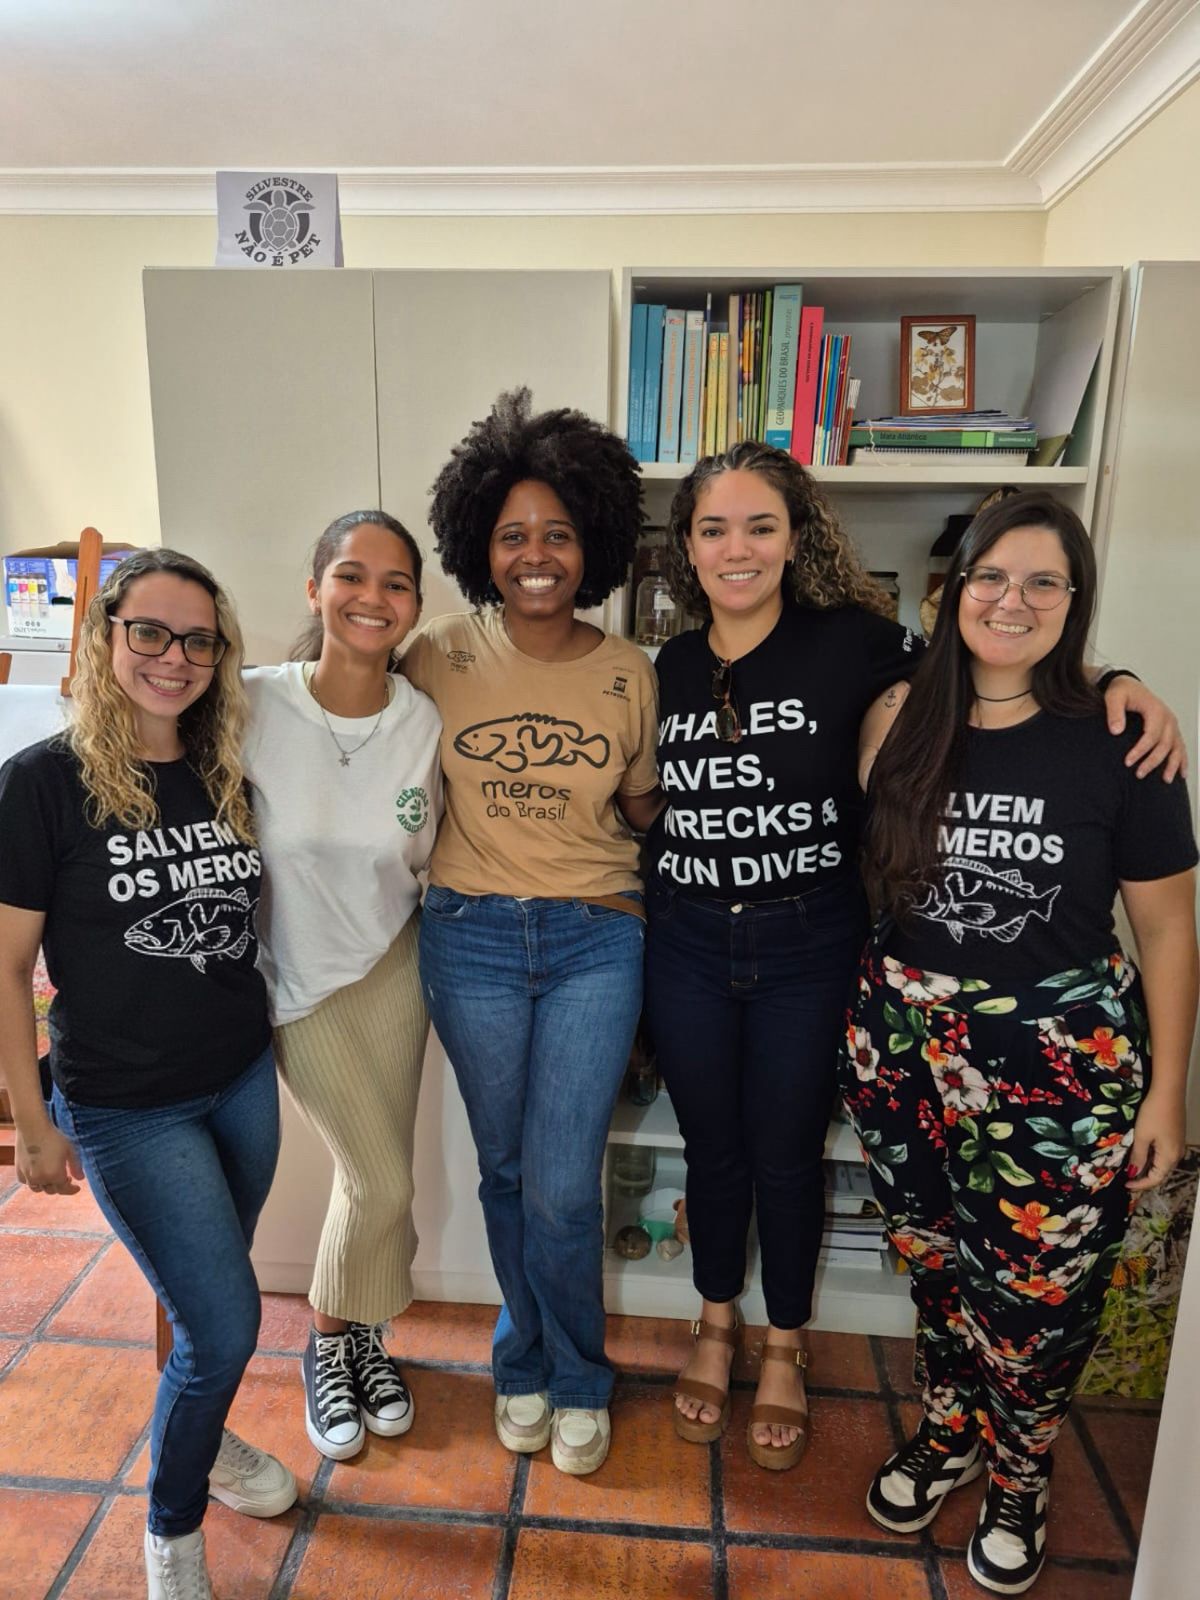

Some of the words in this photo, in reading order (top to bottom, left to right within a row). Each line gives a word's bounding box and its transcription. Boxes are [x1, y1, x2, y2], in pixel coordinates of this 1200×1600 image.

[245, 177, 313, 202] SILVESTRE
[234, 230, 267, 263] NÃO
[271, 251, 284, 267] É
[288, 233, 321, 264] PET
[780, 340, 790, 367] BRASIL
[779, 367, 788, 379] DO
[775, 379, 788, 426] GEOPARQUES
[480, 780, 572, 801] meros
[657, 754, 776, 792] AVES,
[486, 802, 511, 818] do
[516, 802, 567, 820] Brasil
[822, 797, 839, 827] &
[107, 820, 239, 866] SALVEM
[937, 825, 1064, 864] MEROS
[108, 868, 160, 902] OS
[167, 849, 261, 891] MEROS
[658, 850, 720, 887] FUN
[731, 841, 842, 887] DIVES
